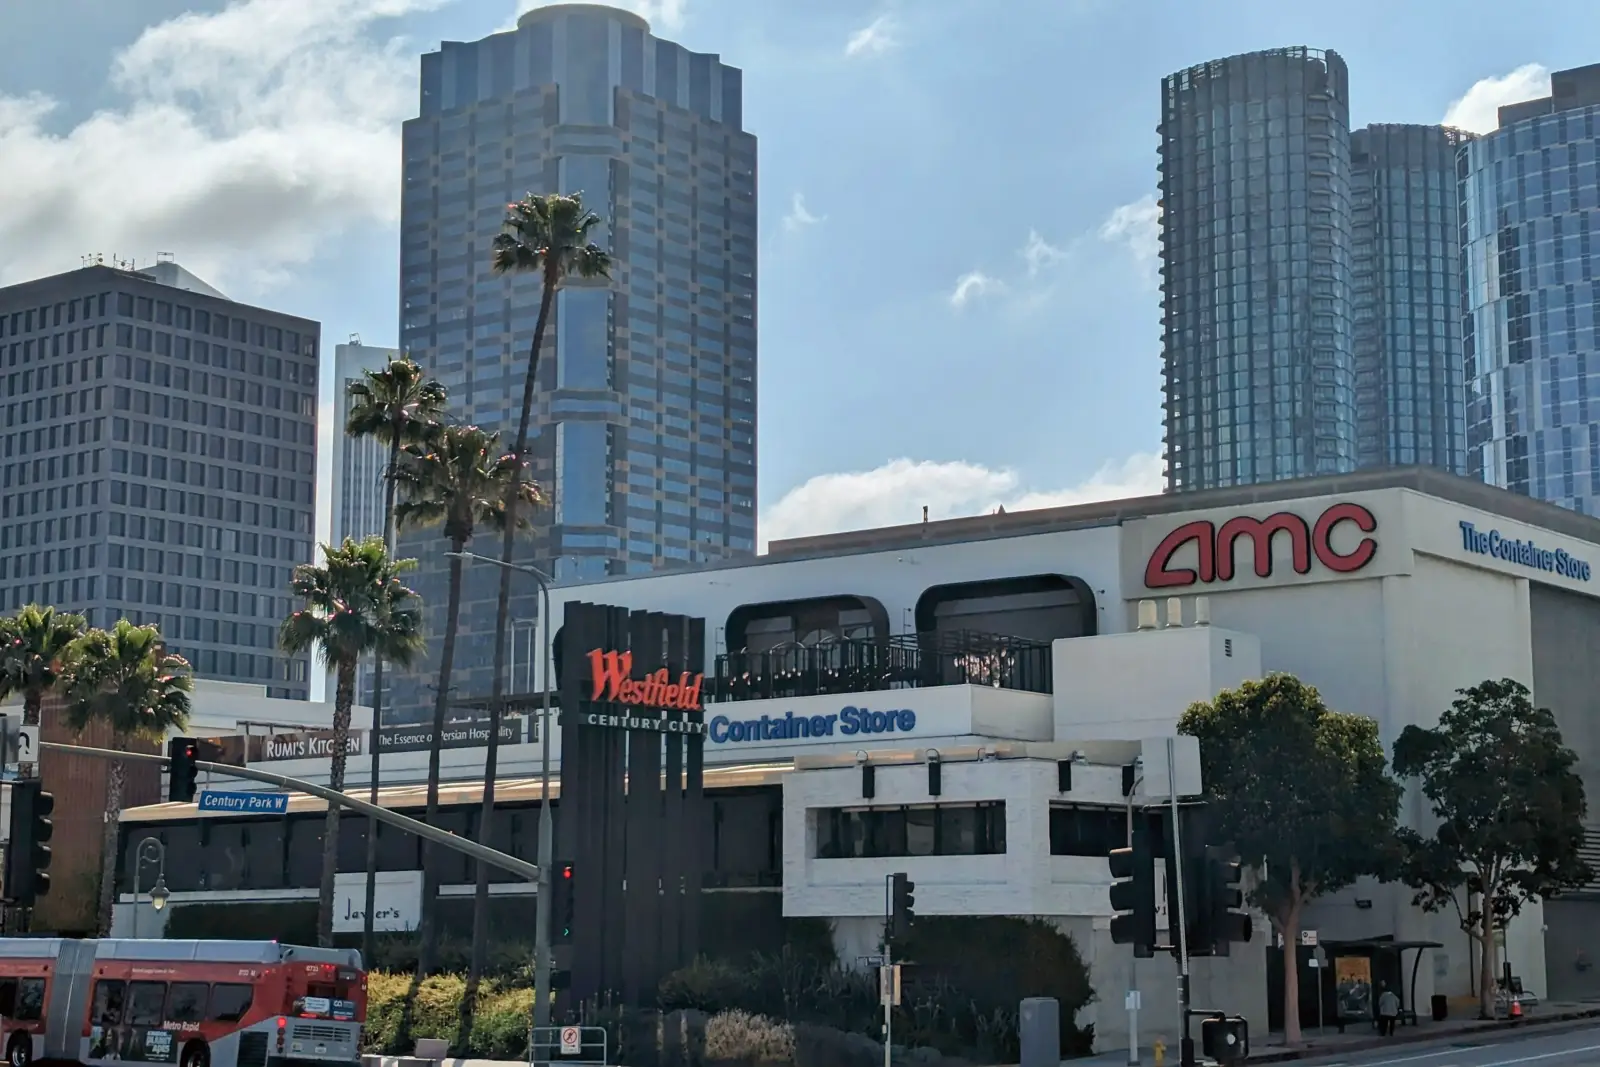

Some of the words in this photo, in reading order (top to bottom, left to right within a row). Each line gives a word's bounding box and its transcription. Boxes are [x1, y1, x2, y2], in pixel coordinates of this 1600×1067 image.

[1459, 521, 1489, 554] The
[1489, 530, 1556, 572] Container
[1556, 548, 1592, 581] Store
[586, 648, 704, 710] Westfield
[588, 713, 661, 730] CENTURY
[668, 720, 704, 733] CITY
[709, 711, 838, 743] Container
[840, 706, 916, 735] Store
[266, 740, 305, 758] RUMI'S
[308, 737, 360, 755] KITCEN
[394, 733, 425, 744] Essence
[205, 795, 245, 809] Century
[249, 797, 272, 808] Park
[275, 798, 284, 808] W
[344, 896, 400, 920] Javer's
[164, 1020, 181, 1030] Metro
[182, 1021, 200, 1032] Rapid
